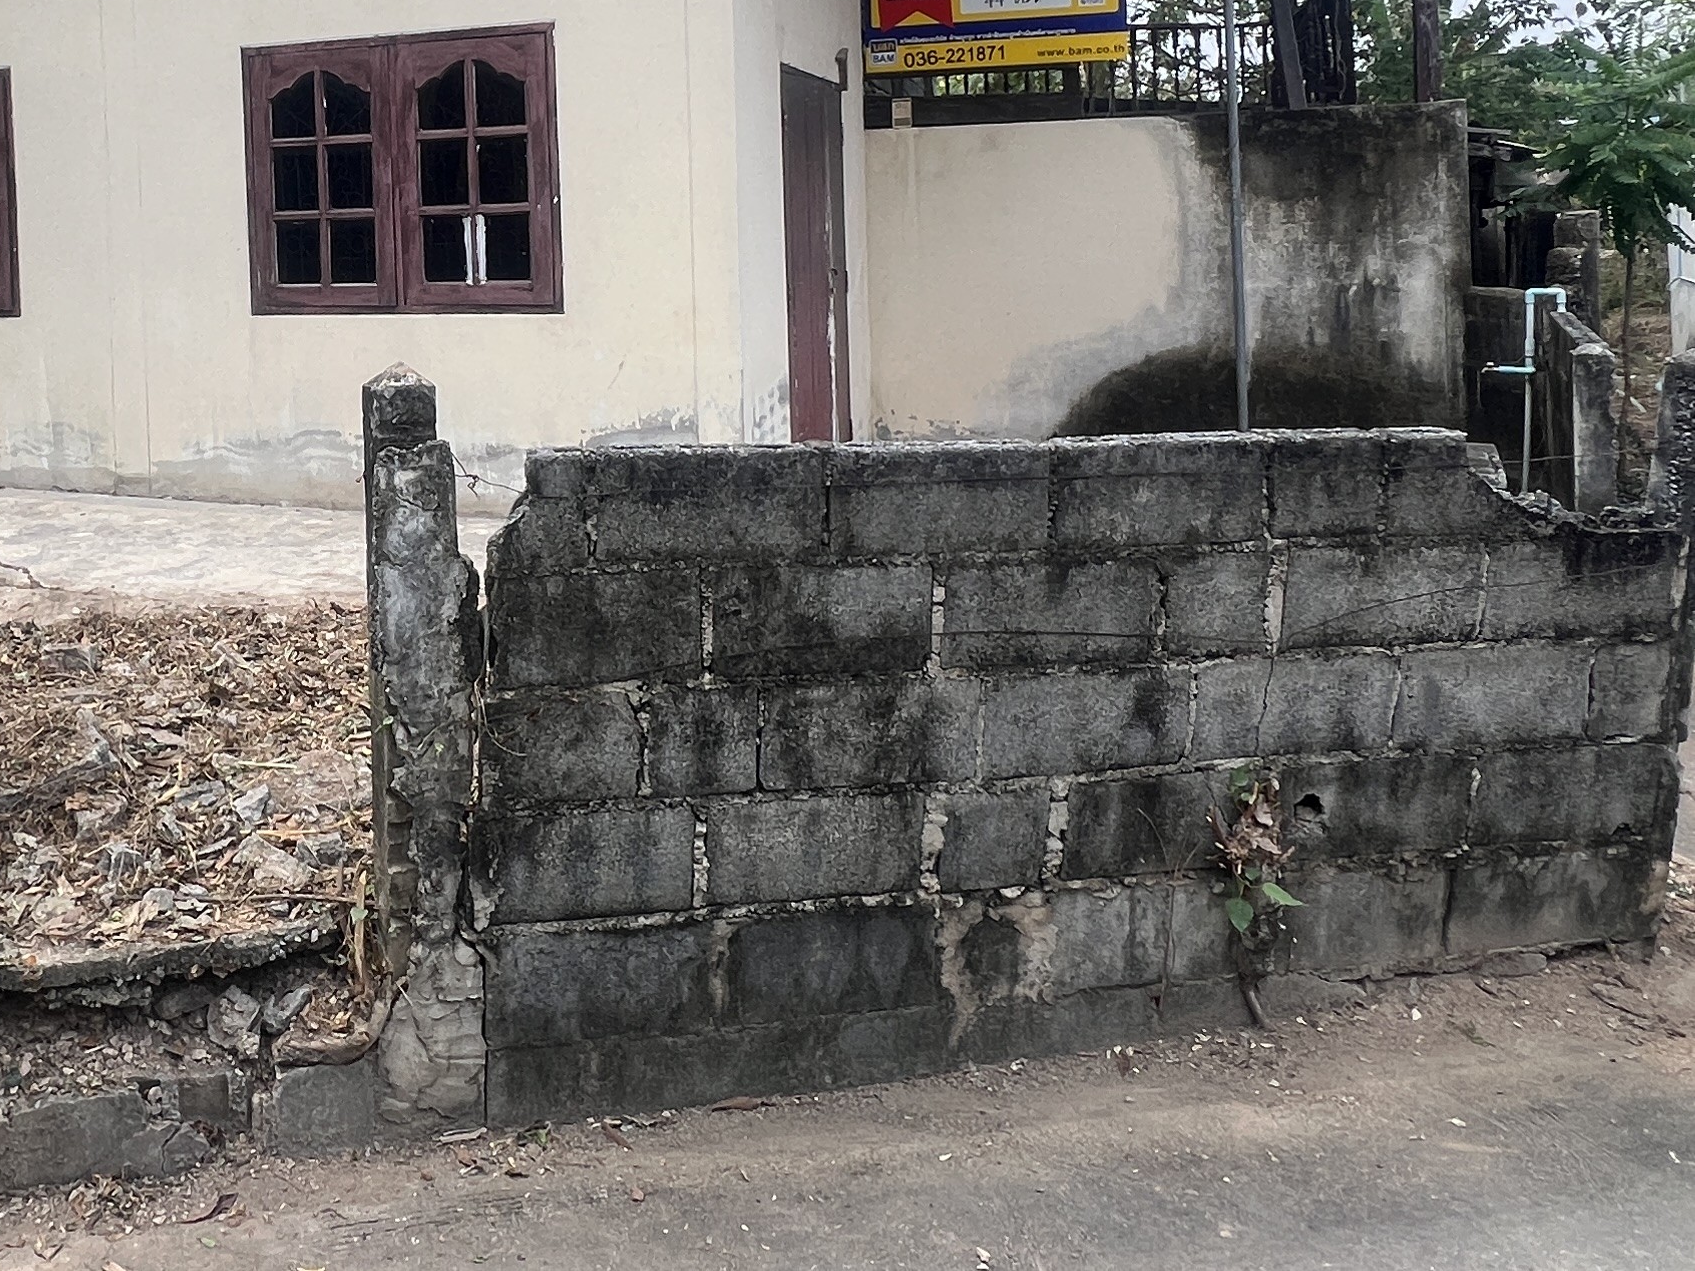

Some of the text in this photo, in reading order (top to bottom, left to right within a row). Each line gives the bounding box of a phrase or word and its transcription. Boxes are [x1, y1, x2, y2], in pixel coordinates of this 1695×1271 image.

[903, 45, 1006, 68] 036-221871
[1037, 44, 1126, 58] www.bam.co.th
[872, 54, 895, 64] BAM
